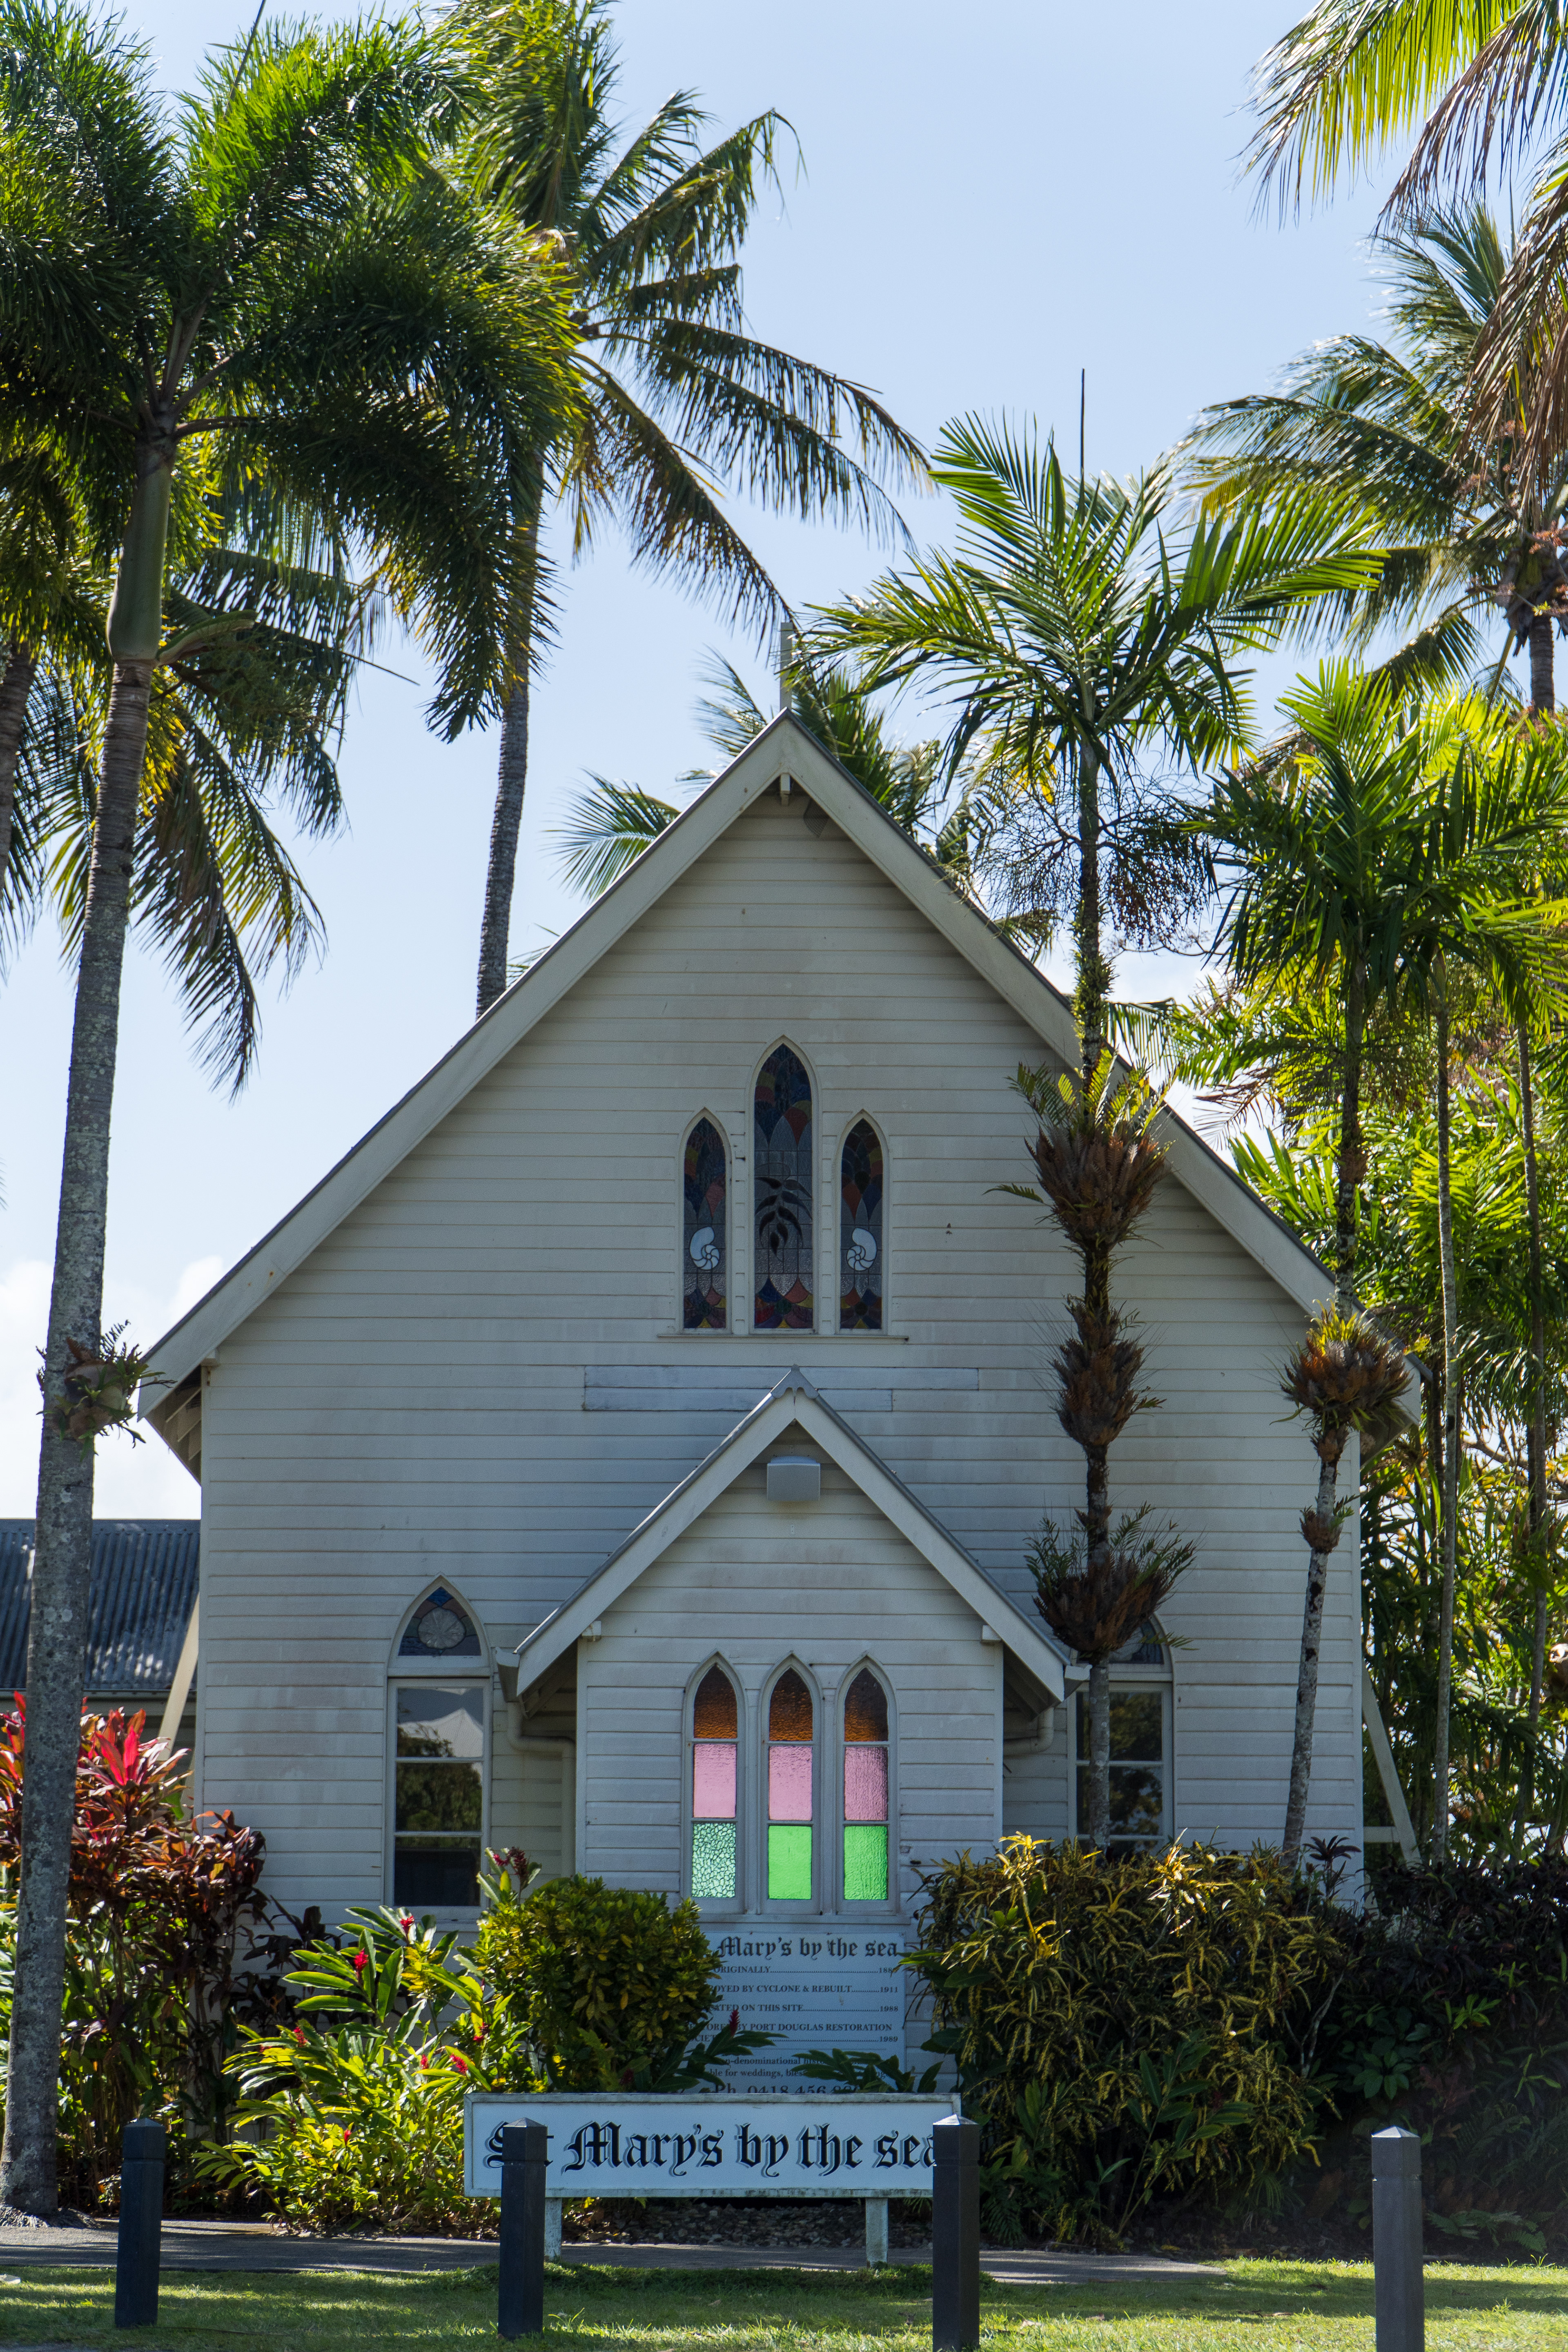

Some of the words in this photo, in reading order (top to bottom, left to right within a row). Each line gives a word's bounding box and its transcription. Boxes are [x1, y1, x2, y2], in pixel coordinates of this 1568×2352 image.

[800, 1937, 822, 1960] by
[829, 1937, 858, 1960] the
[865, 1940, 898, 1957] sea
[725, 2068, 738, 2076] for
[740, 2069, 784, 2079] weddings,
[561, 2120, 724, 2177] Mary's
[735, 2123, 789, 2178] by
[797, 2123, 863, 2177] the
